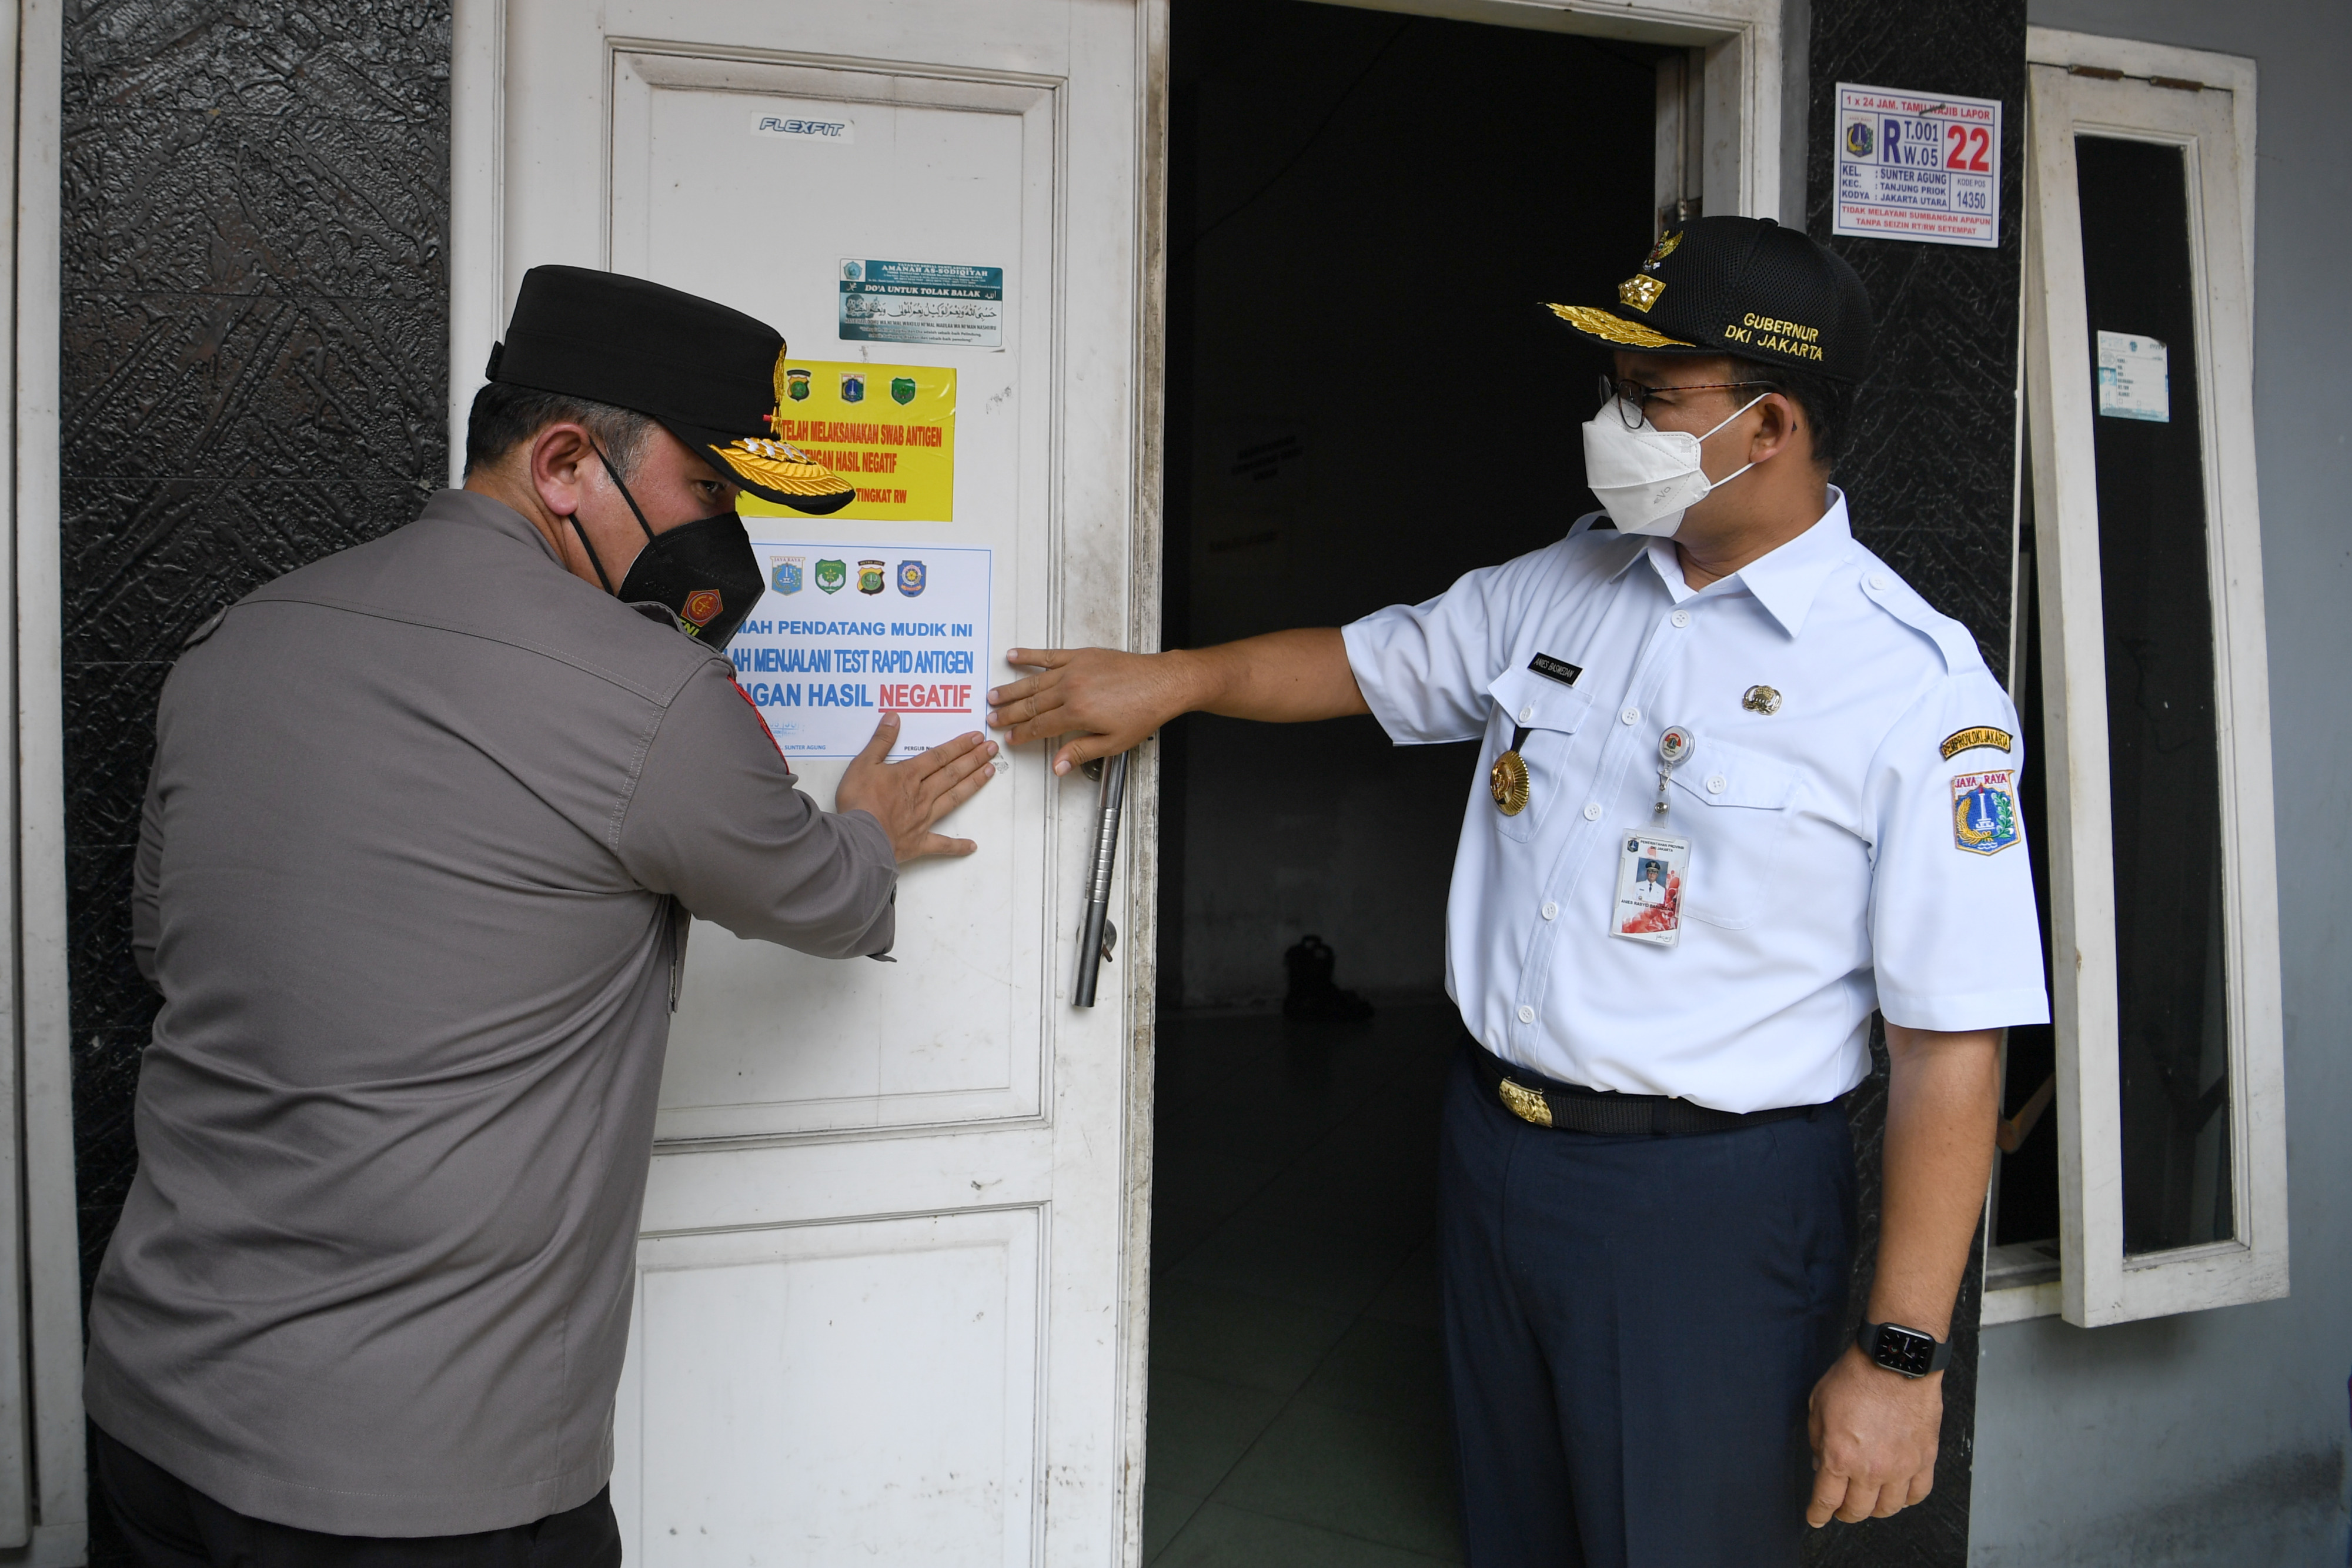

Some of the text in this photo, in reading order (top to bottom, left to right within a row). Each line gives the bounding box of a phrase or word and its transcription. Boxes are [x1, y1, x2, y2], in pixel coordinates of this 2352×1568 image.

[1847, 95, 1851, 105] 1
[1863, 96, 1874, 106] 24
[1876, 99, 1898, 110] JAM.
[1901, 101, 1927, 112] TAMU
[1961, 108, 1990, 120] LAPOR
[759, 117, 845, 136] FLEXFIT
[1904, 121, 1938, 142] T.001
[1883, 119, 1901, 163] R
[1946, 125, 1990, 172] 22
[1904, 145, 1938, 167] W.05
[1842, 165, 1862, 176] KEL.
[1880, 168, 1915, 182] SUNTER
[1917, 172, 1947, 185] AGUNG
[1975, 179, 1986, 188] POS
[1842, 179, 1862, 188] KEC.
[1880, 182, 1919, 193] TANJUNG
[1921, 186, 1946, 196] PRIOK
[1842, 190, 1870, 200] KODYA
[1880, 193, 1918, 204] JAKARTA
[1920, 197, 1947, 207] UTARA
[1957, 190, 1986, 209] 14350
[1842, 206, 1991, 225] TIDAK MELAYANI SUMBANGAN APAPUN
[1856, 218, 1976, 234] TANPA SEIZIN RT/RW SETEMPAT
[882, 265, 922, 273] AMANAH
[887, 286, 918, 294] UNTUK
[920, 287, 950, 296] TOLAK
[1744, 312, 1819, 343] GUBERNUR
[1724, 325, 1823, 361] DKI JAKARTA
[782, 420, 942, 447] TELAH MELAKSANAKAN SWAB ANTIGEN
[836, 451, 860, 472] HASIL
[862, 452, 897, 473] NEGATIF
[856, 488, 907, 504] TINGKAT RW
[779, 621, 886, 636] PENDATANG
[891, 623, 947, 636] MUDIK
[951, 623, 972, 637] INI
[754, 648, 831, 673] MENJALANI
[834, 649, 870, 673] TEST
[872, 650, 913, 673] RAPID
[914, 650, 973, 674] ANTIGEN
[1534, 657, 1575, 678] ANIES BASWEDAN
[808, 684, 873, 707] HASIL
[880, 684, 971, 707] NEGATIF
[1983, 730, 2009, 749] JAKARTA
[1955, 773, 2007, 788] JAYA RAYA
